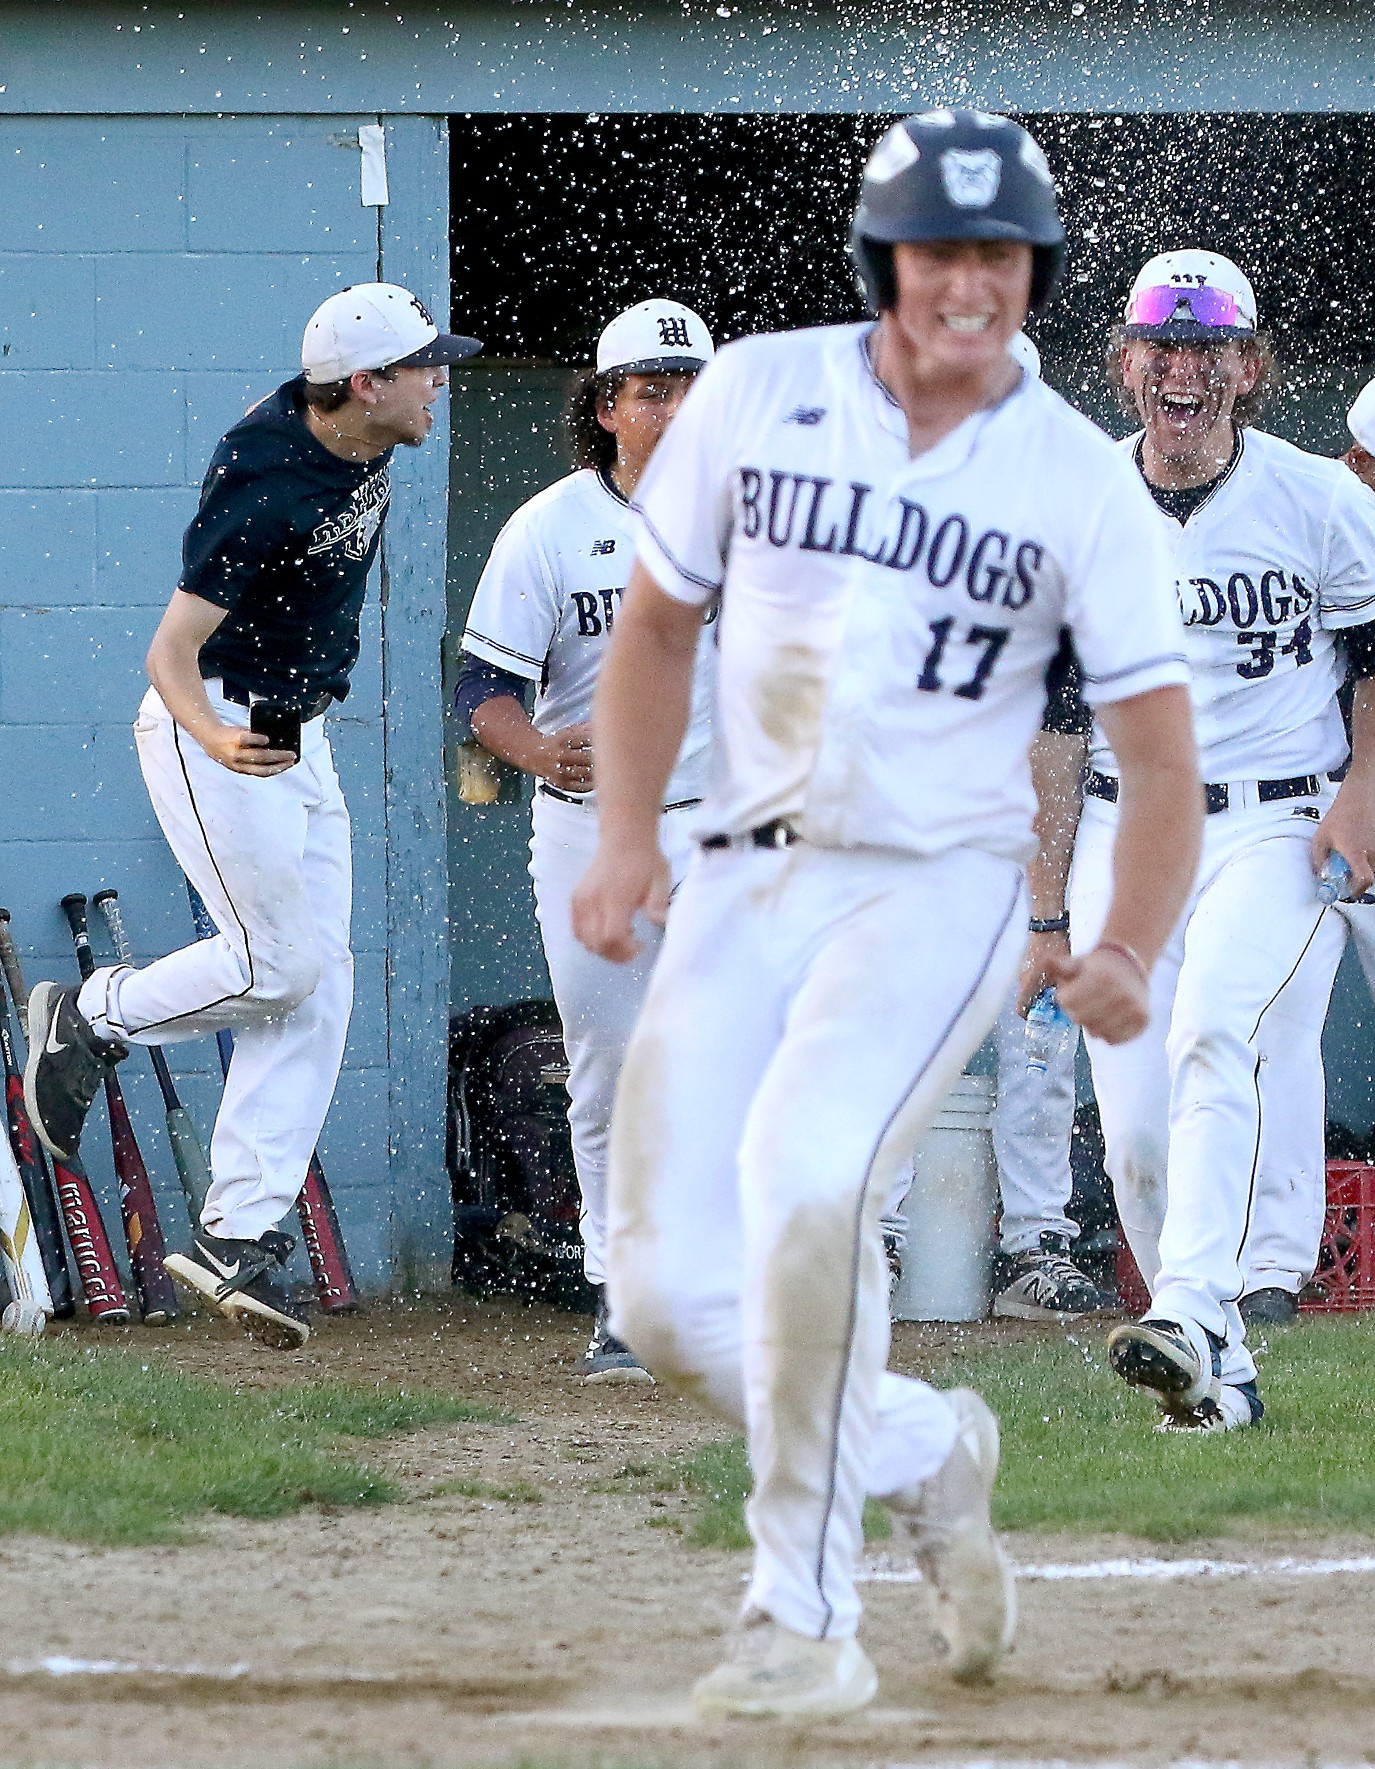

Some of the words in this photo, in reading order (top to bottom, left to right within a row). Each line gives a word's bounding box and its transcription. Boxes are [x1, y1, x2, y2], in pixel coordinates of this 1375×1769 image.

[740, 466, 1045, 611] BULLDOGS
[1176, 570, 1314, 629] DOGS
[917, 614, 1010, 700] 17
[1236, 615, 1314, 679] 34
[59, 1182, 119, 1311] marucci
